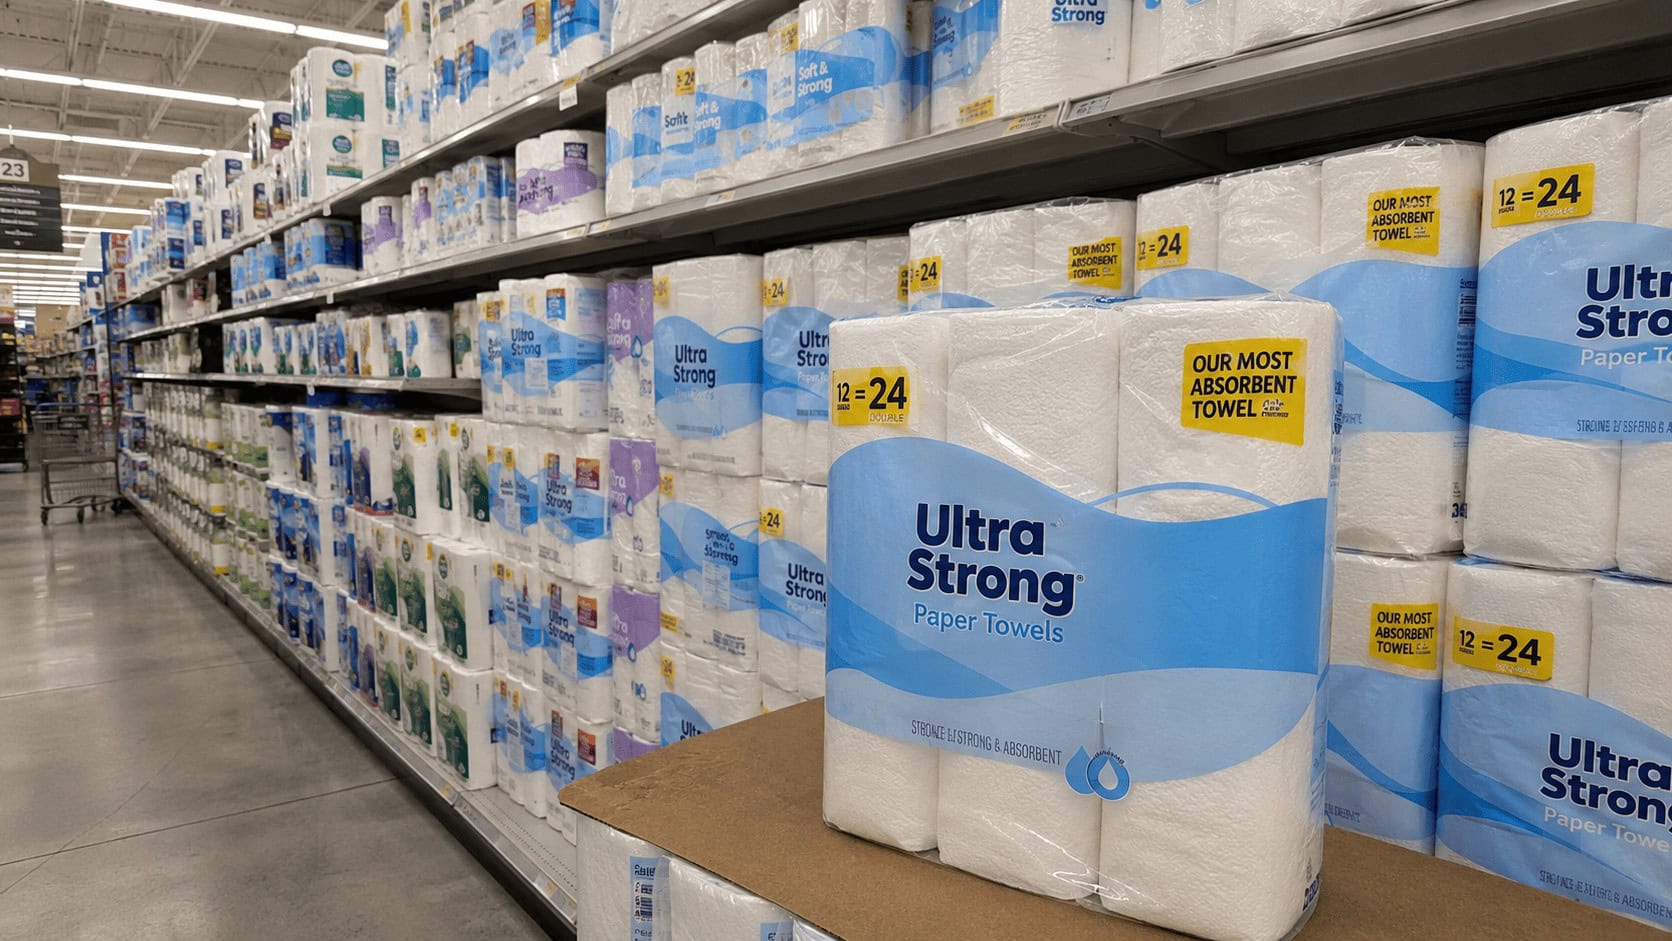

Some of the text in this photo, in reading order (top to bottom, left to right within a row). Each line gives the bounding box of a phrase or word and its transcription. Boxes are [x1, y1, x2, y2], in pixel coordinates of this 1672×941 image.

[1052, 7, 1106, 26] Strong
[799, 60, 829, 81] Soft &
[797, 77, 833, 97] Strong
[1, 162, 25, 178] 23
[1498, 173, 1582, 208] 12 = 24
[1373, 195, 1433, 212] OUR MOST
[1371, 211, 1435, 227] ABSORBENT
[1373, 226, 1412, 242] TOWEL
[1072, 242, 1117, 257] OUR MOST
[1157, 232, 1182, 258] 24
[920, 261, 938, 282] 24
[1071, 254, 1118, 268] ABSORBENT
[1073, 267, 1100, 279] TOWEL
[771, 281, 785, 298] 24
[1575, 304, 1672, 339] Stro
[511, 328, 535, 342] Ultra
[799, 329, 829, 349] Ultr
[511, 342, 541, 358] Strong
[675, 344, 708, 364] Ultra
[797, 349, 829, 367] Stro
[1580, 348, 1648, 370] Paper
[1193, 350, 1294, 374] OUR MOST
[673, 364, 717, 389] Strong
[1190, 374, 1298, 397] ABSORBENT
[837, 376, 907, 410] 12 = 24
[1191, 398, 1258, 420] TOWEL
[545, 492, 573, 514] Strong
[767, 511, 780, 529] 24
[916, 502, 1046, 557] Ultra
[787, 562, 825, 586] Ultra
[914, 603, 1065, 644] Paper Towels
[1377, 611, 1432, 625] OUR MOST
[1375, 626, 1435, 641] ABSORBENT
[1376, 640, 1414, 655] TOWEL
[1459, 629, 1542, 666] 12 = 24
[994, 738, 1001, 752] &
[1003, 740, 1063, 766] ABSORBENT
[1548, 731, 1672, 792] Ultra
[1539, 766, 1672, 834] Stron
[1543, 805, 1671, 854] Paper Towe
